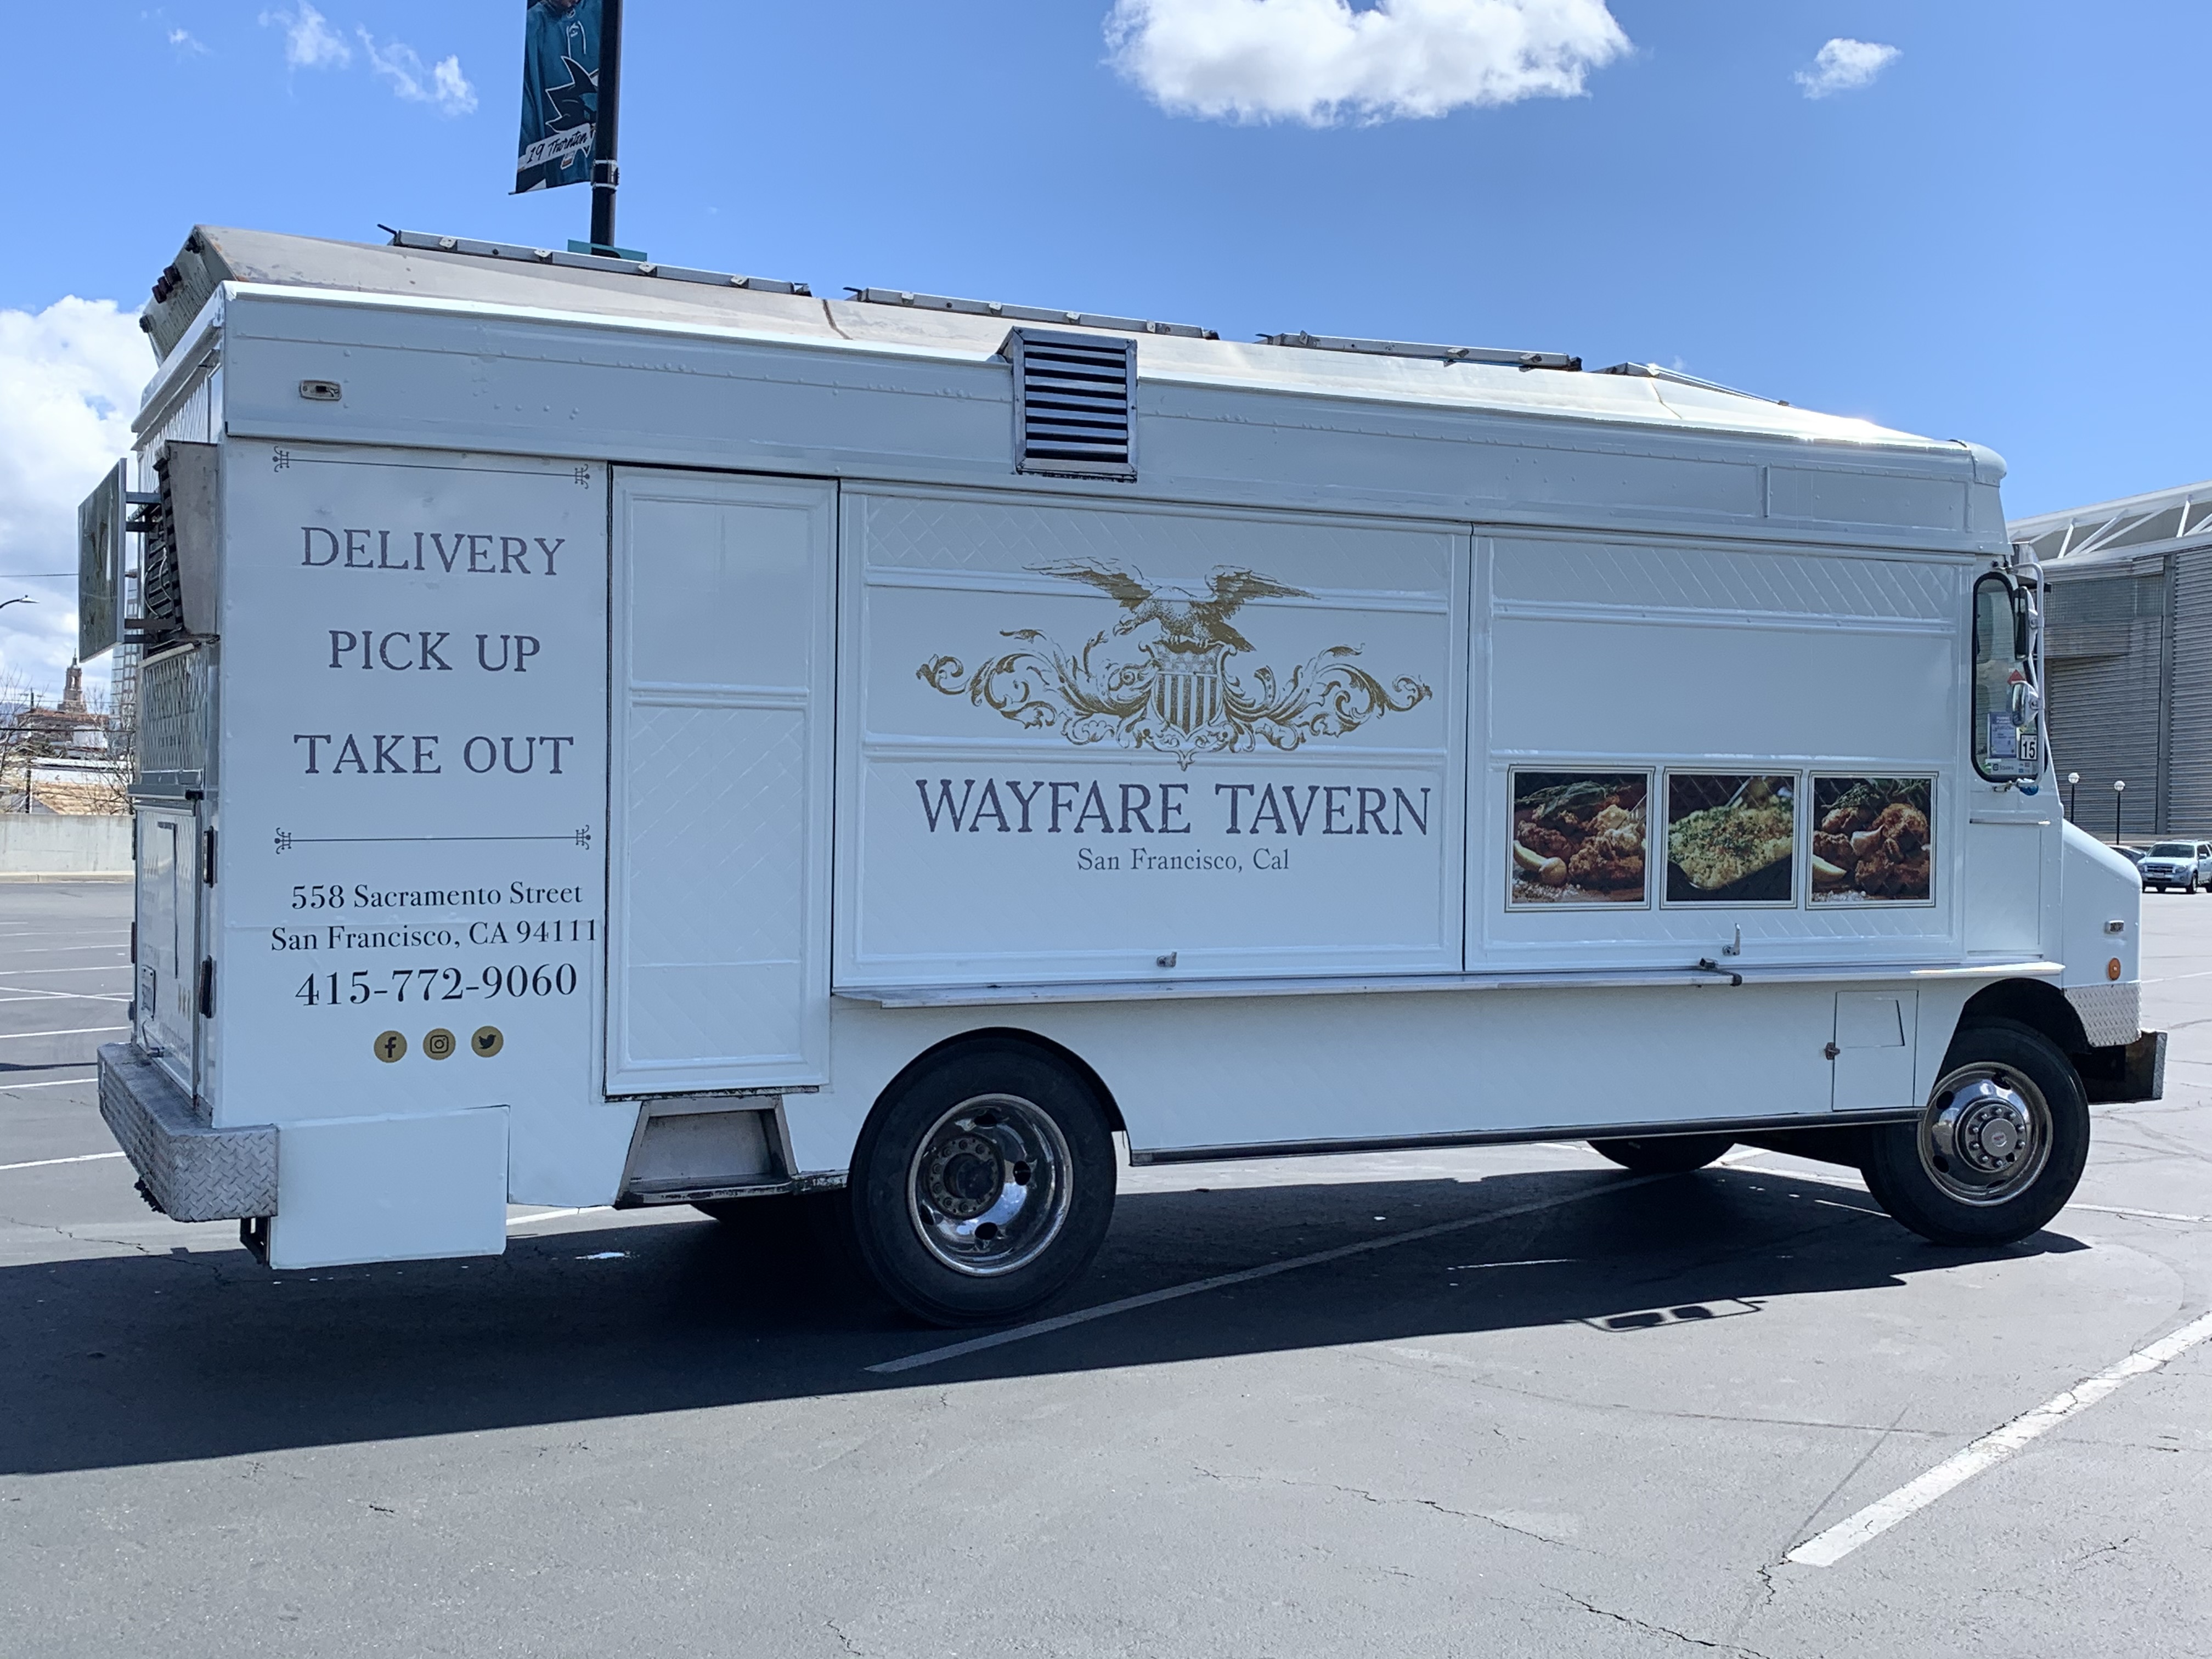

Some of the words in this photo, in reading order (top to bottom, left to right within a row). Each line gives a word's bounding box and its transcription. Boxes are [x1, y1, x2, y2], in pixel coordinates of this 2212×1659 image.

[527, 143, 545, 163] 19
[548, 131, 587, 157] Thornton
[301, 527, 566, 575] DELIVERY
[329, 630, 453, 671] PICK
[475, 634, 540, 672] UP
[294, 733, 442, 774] TAKE
[464, 736, 574, 775] OUT
[2023, 741, 2035, 758] 15
[915, 778, 1191, 834] WAYFARE
[1215, 782, 1431, 836] TAVERN
[1077, 848, 1120, 870] San
[1130, 847, 1243, 873] Francisco,
[1253, 848, 1289, 870] Cal
[291, 884, 345, 910] 558
[354, 884, 501, 908] Sacramento
[510, 881, 583, 904] Street
[271, 927, 318, 951] San
[327, 924, 460, 949] Francisco,
[469, 921, 510, 945] CA
[516, 918, 597, 944] 94111
[295, 963, 577, 1007] 415-772-9060
